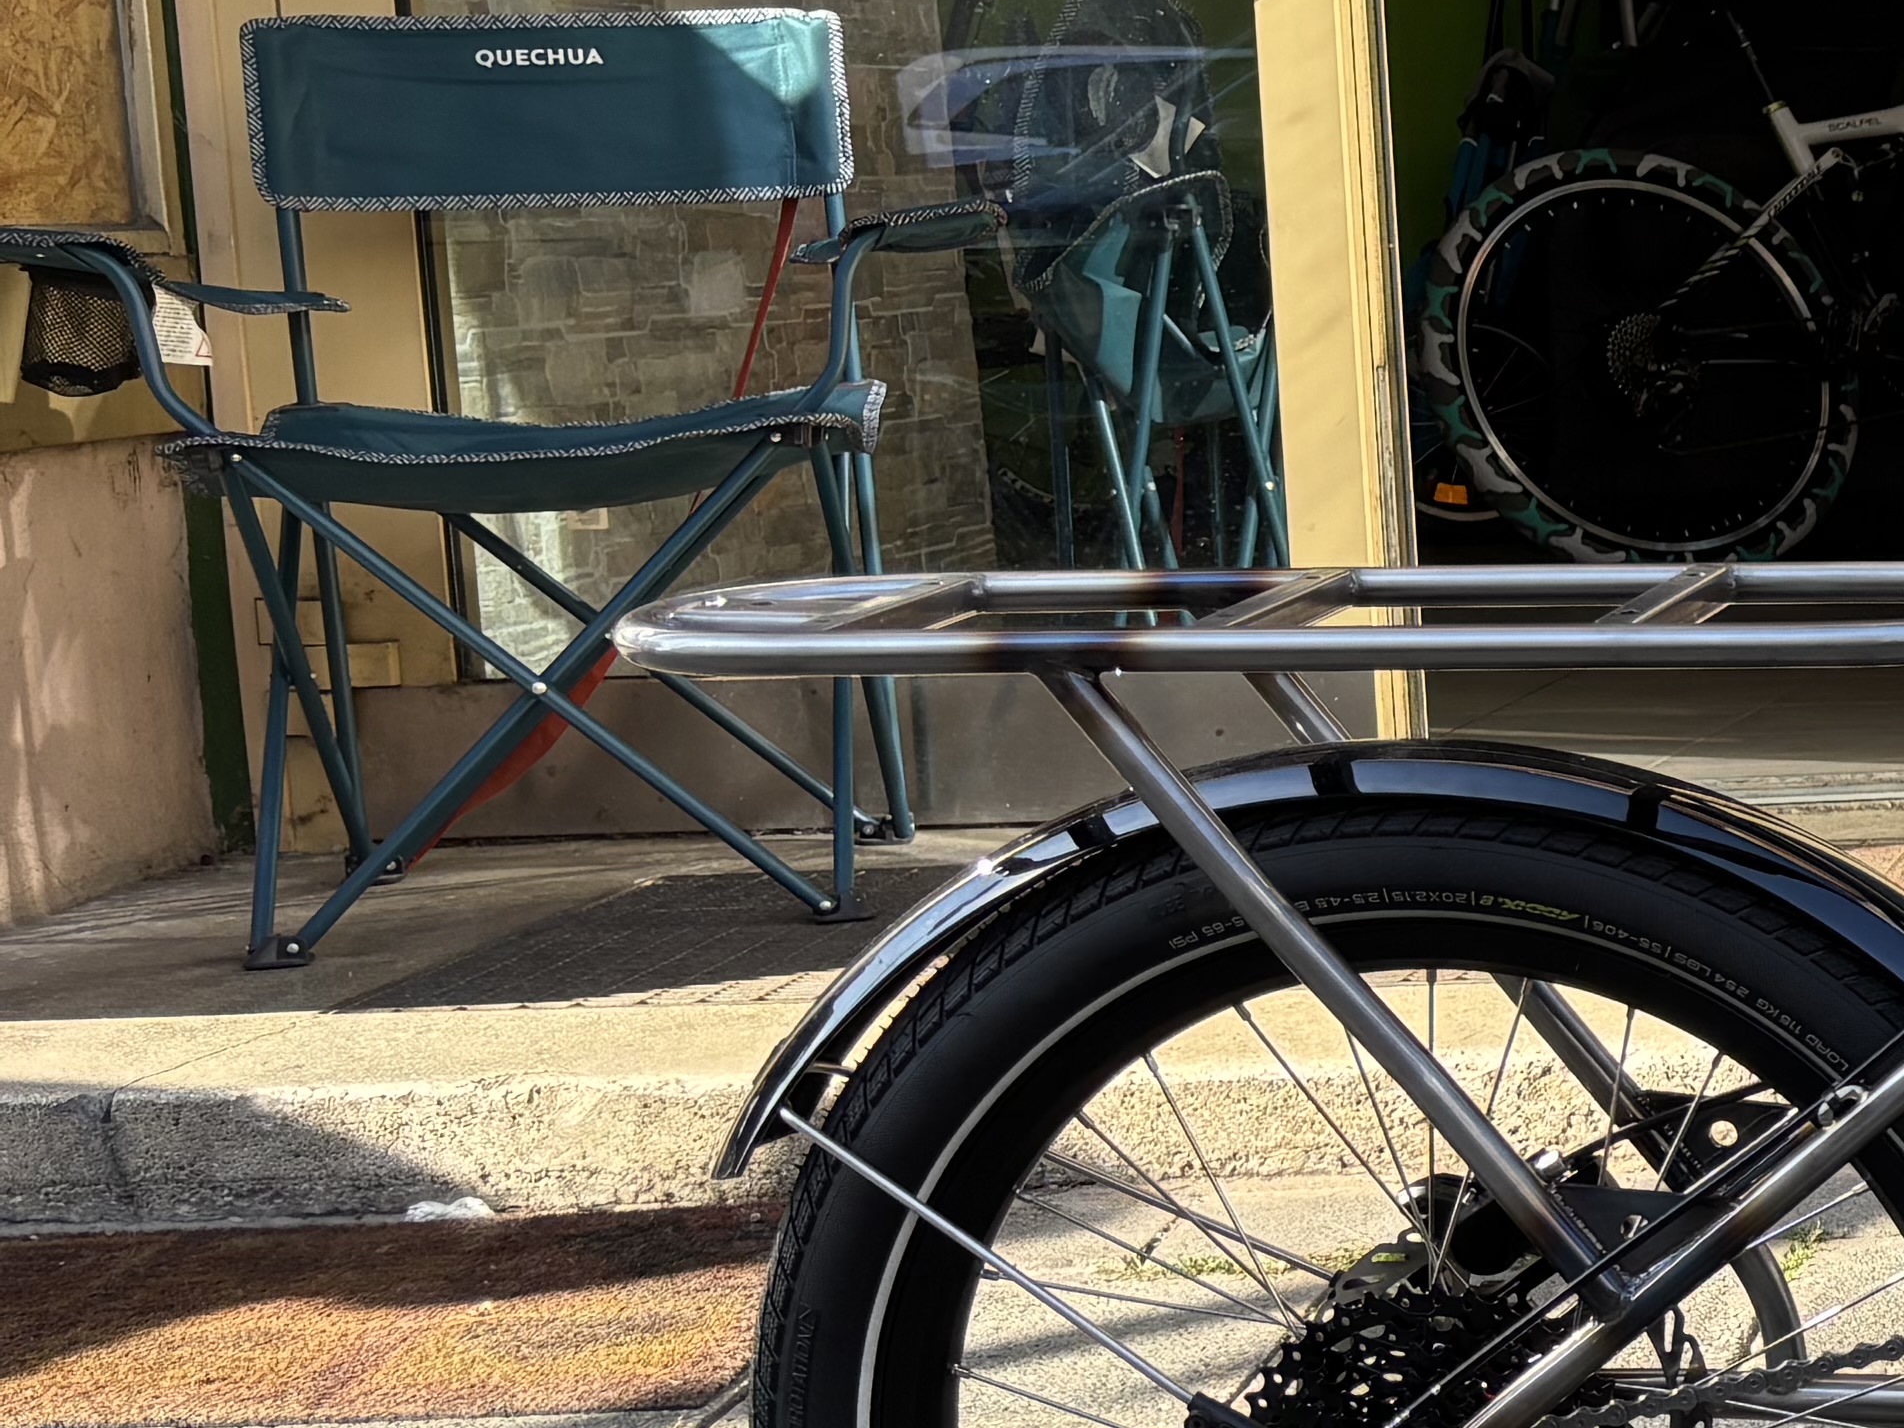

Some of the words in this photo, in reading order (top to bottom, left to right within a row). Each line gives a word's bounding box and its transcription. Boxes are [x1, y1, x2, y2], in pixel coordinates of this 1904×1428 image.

[475, 48, 604, 68] QUECHUA
[1201, 912, 1245, 939] 5-65
[1168, 929, 1199, 951] PSI
[1753, 997, 1780, 1018] KG
